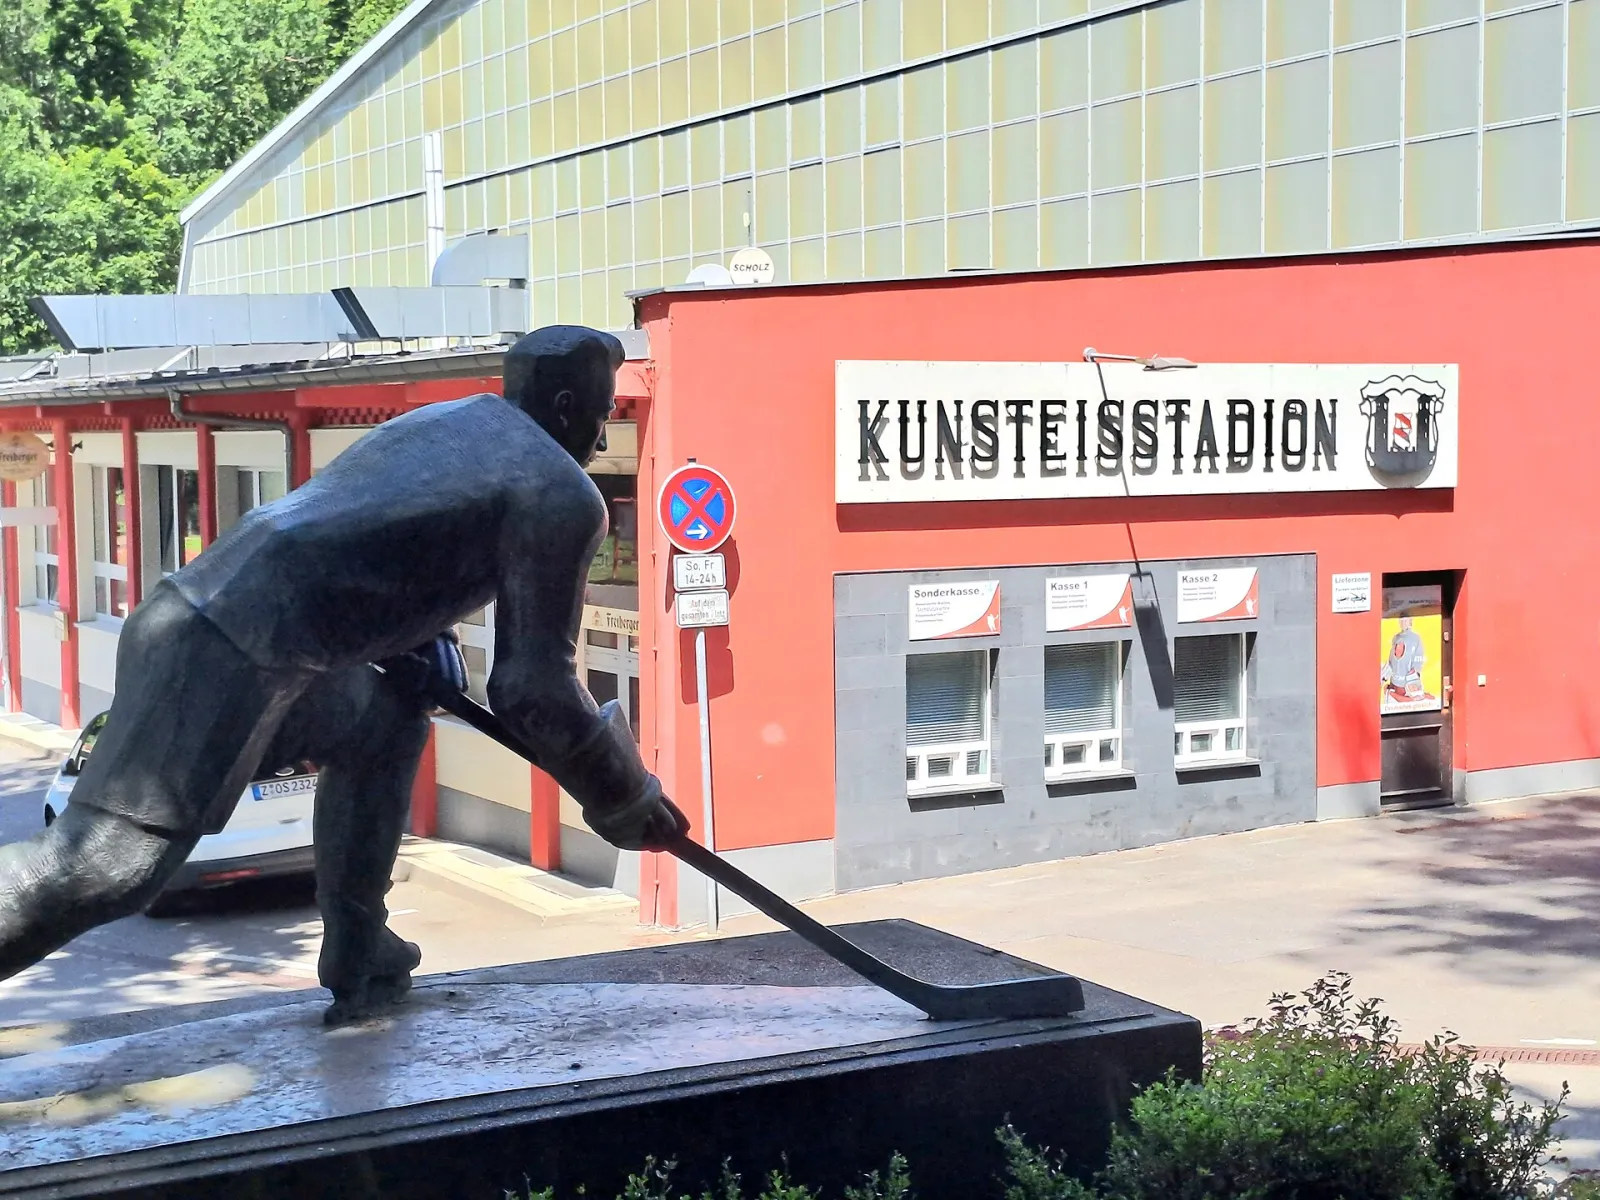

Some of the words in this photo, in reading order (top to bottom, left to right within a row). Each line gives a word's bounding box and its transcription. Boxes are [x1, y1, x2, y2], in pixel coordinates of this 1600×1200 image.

[733, 263, 769, 272] SCHOLZ
[857, 398, 1338, 465] KUNSTEISSTADION
[704, 560, 714, 570] Fr
[1182, 575, 1210, 583] Kasse
[1212, 573, 1218, 582] 2
[1334, 576, 1369, 584] Lieferzone
[1050, 582, 1080, 591] Kasse
[1083, 580, 1088, 590] 1
[914, 587, 980, 598] Sonderkasse
[262, 785, 269, 796] Z
[275, 782, 290, 794] OS
